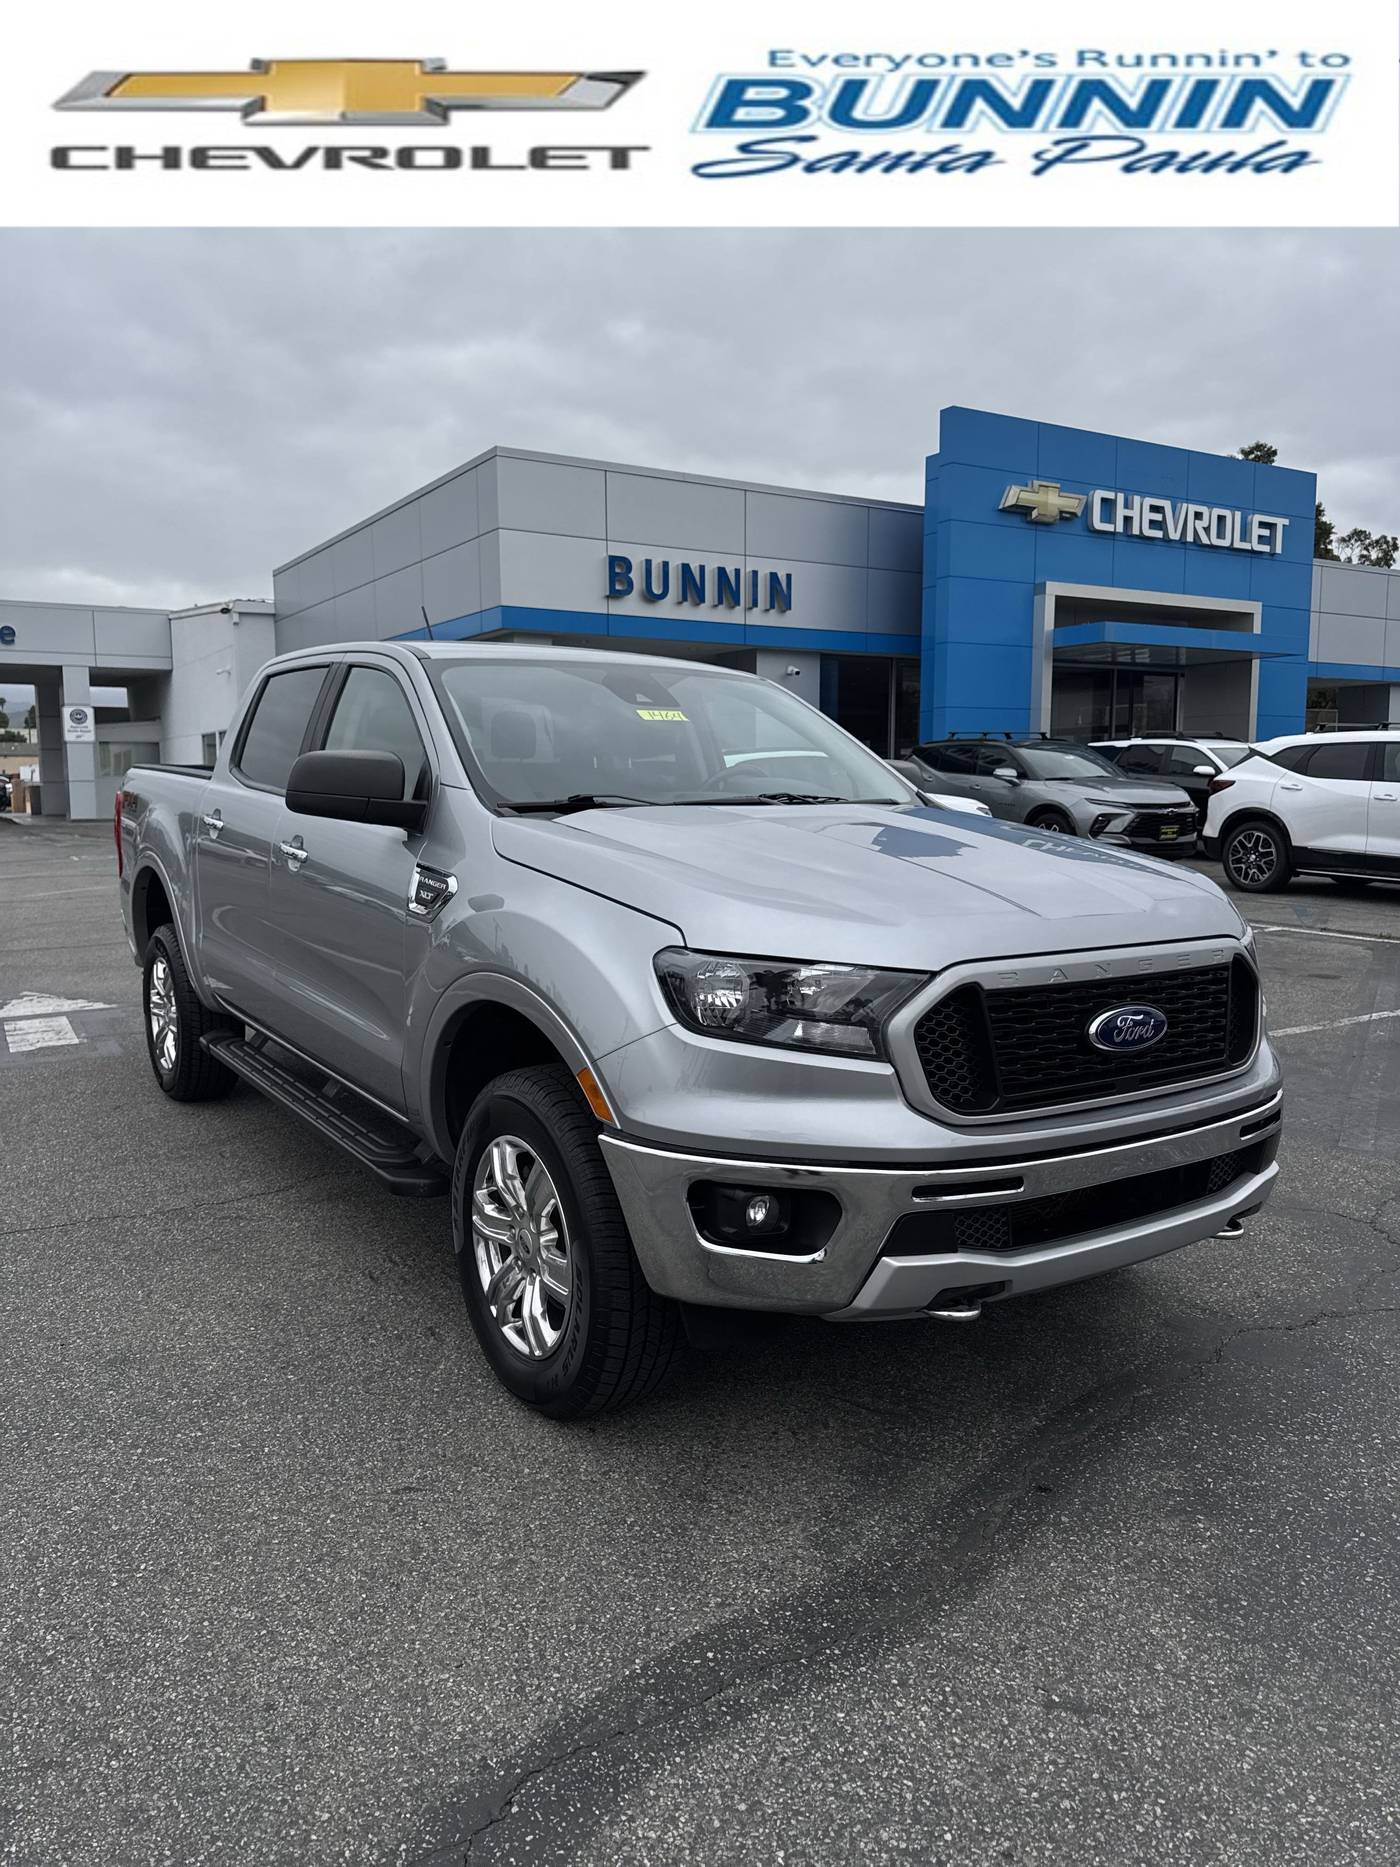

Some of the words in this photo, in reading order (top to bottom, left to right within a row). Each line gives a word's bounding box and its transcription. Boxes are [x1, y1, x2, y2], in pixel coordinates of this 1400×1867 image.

[1089, 488, 1290, 555] CHEVROLET
[606, 554, 792, 612] BUNNIN
[419, 876, 447, 890] RANGER
[419, 889, 434, 900] XLT
[996, 948, 1226, 986] RANGER
[1112, 1013, 1156, 1043] Ford
